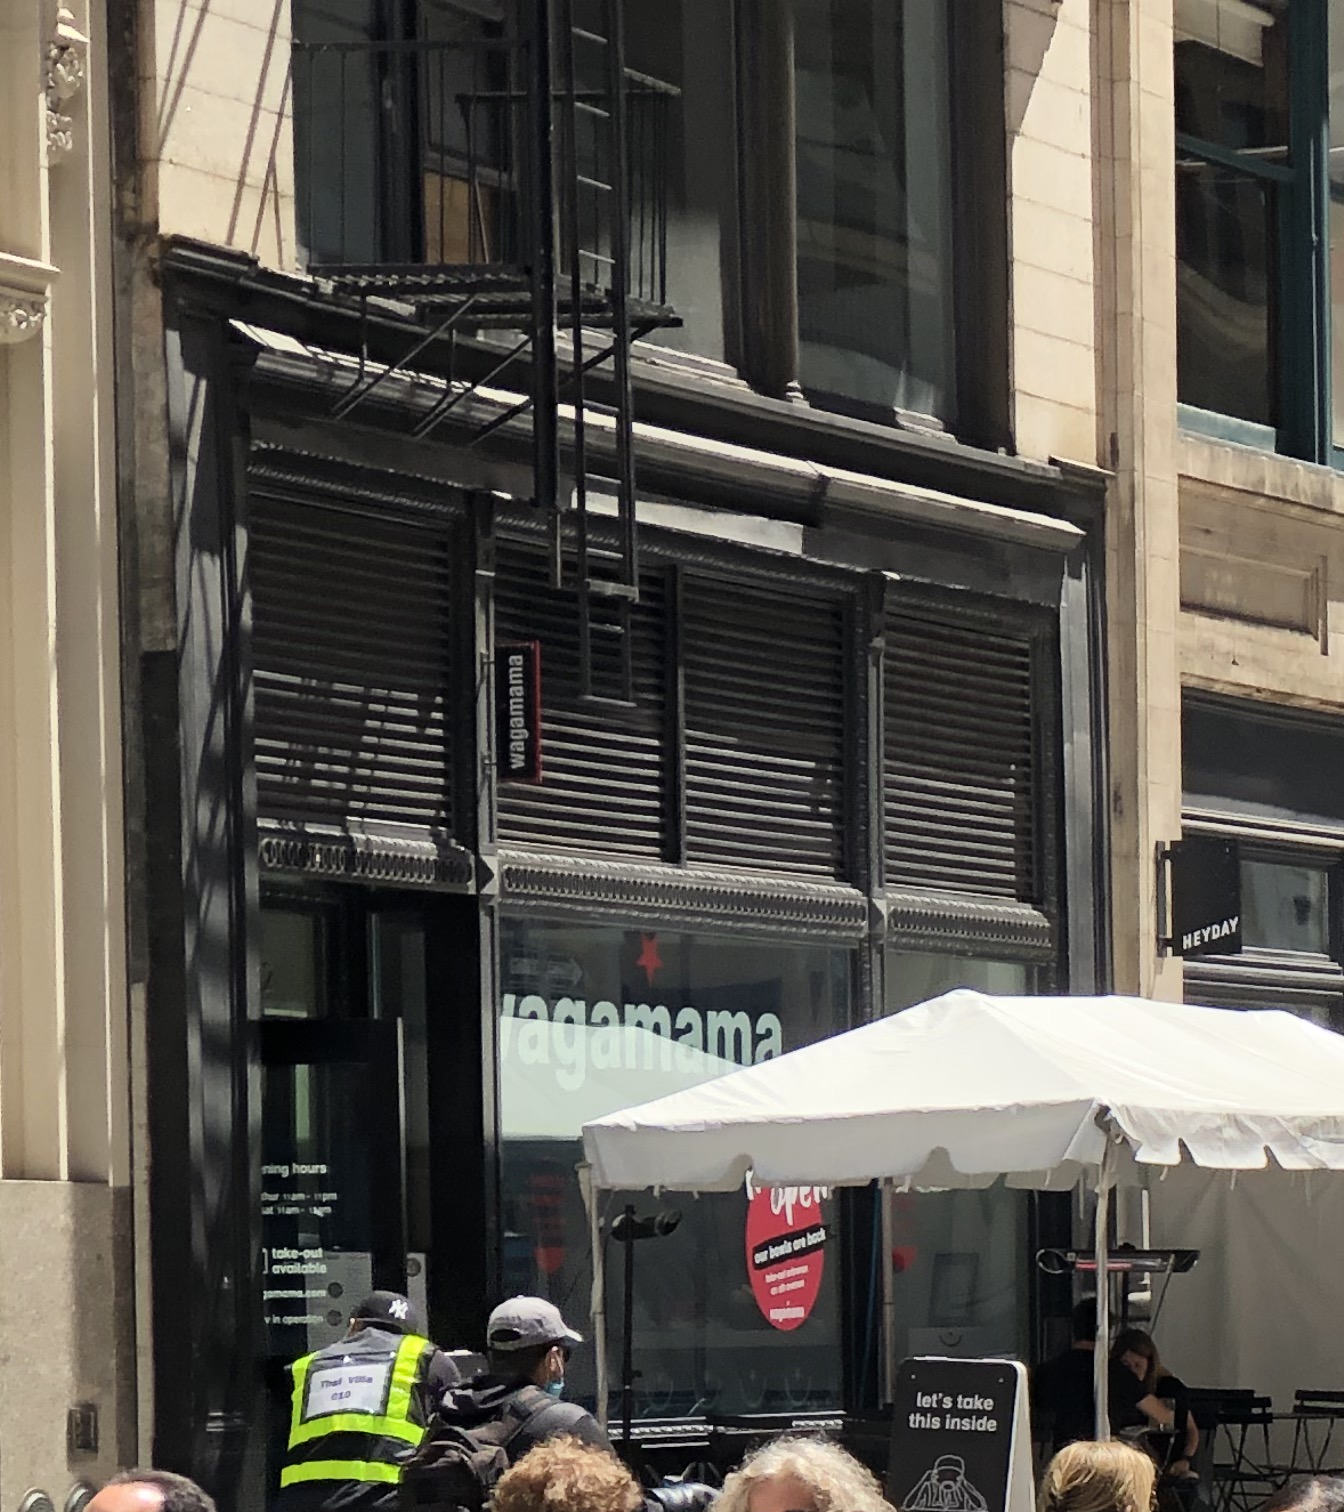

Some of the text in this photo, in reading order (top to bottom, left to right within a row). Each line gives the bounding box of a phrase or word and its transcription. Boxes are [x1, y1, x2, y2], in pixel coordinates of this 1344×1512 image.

[508, 654, 530, 769] wagamama
[1182, 916, 1239, 950] HEYDAY
[262, 1163, 327, 1178] ning hours
[271, 1247, 323, 1259] take-out
[754, 1249, 769, 1265] our
[806, 1227, 827, 1246] back
[271, 1263, 327, 1274] available
[916, 1392, 995, 1411] let's take
[908, 1413, 998, 1432] this inside
